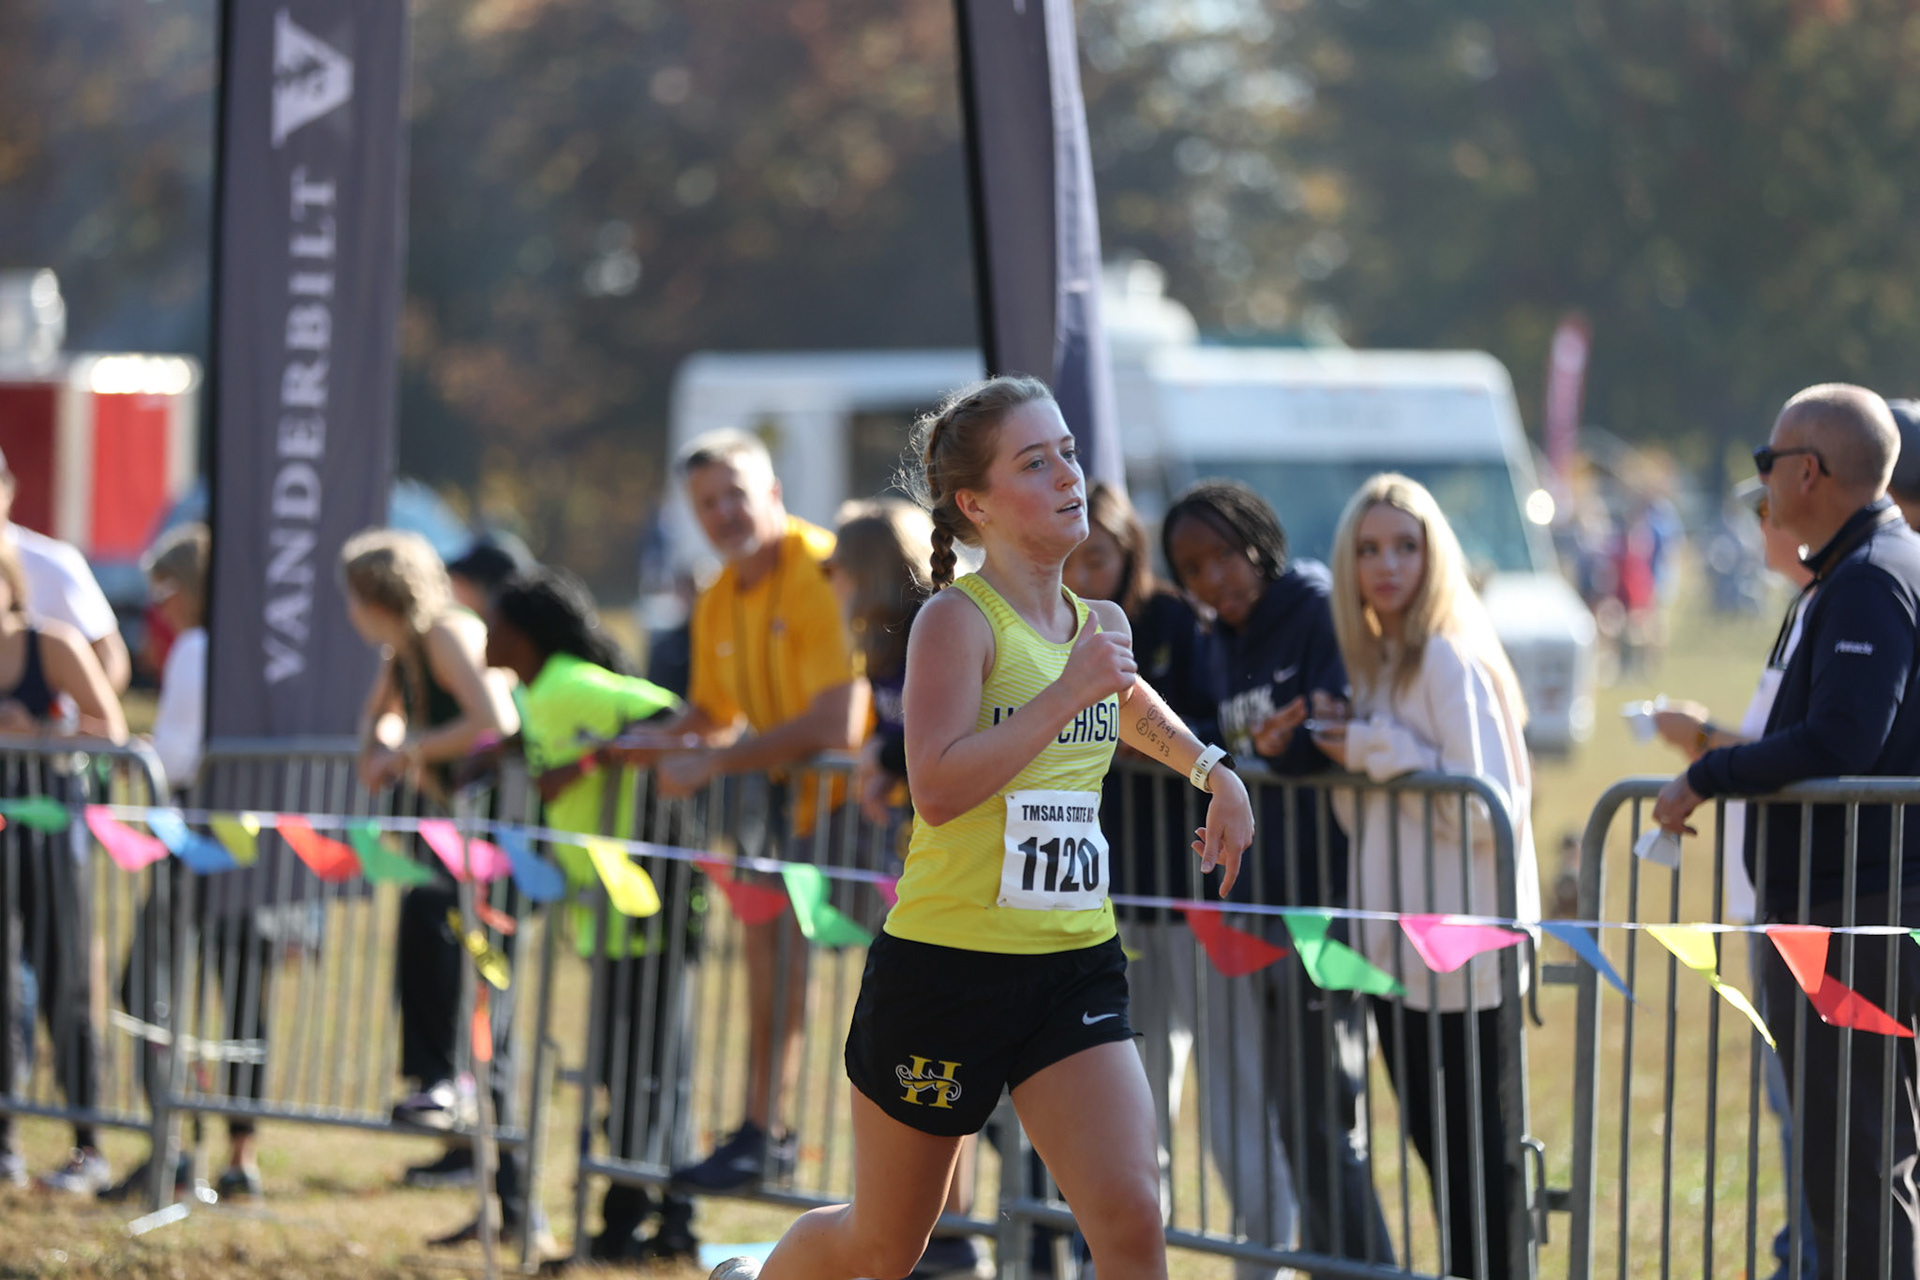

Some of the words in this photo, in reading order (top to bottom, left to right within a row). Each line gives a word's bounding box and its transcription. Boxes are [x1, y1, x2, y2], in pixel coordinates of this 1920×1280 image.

[262, 166, 336, 684] VANDERBILT
[1022, 805, 1064, 822] TMSAA
[1066, 806, 1086, 823] STATE
[1018, 837, 1099, 892] 1120
